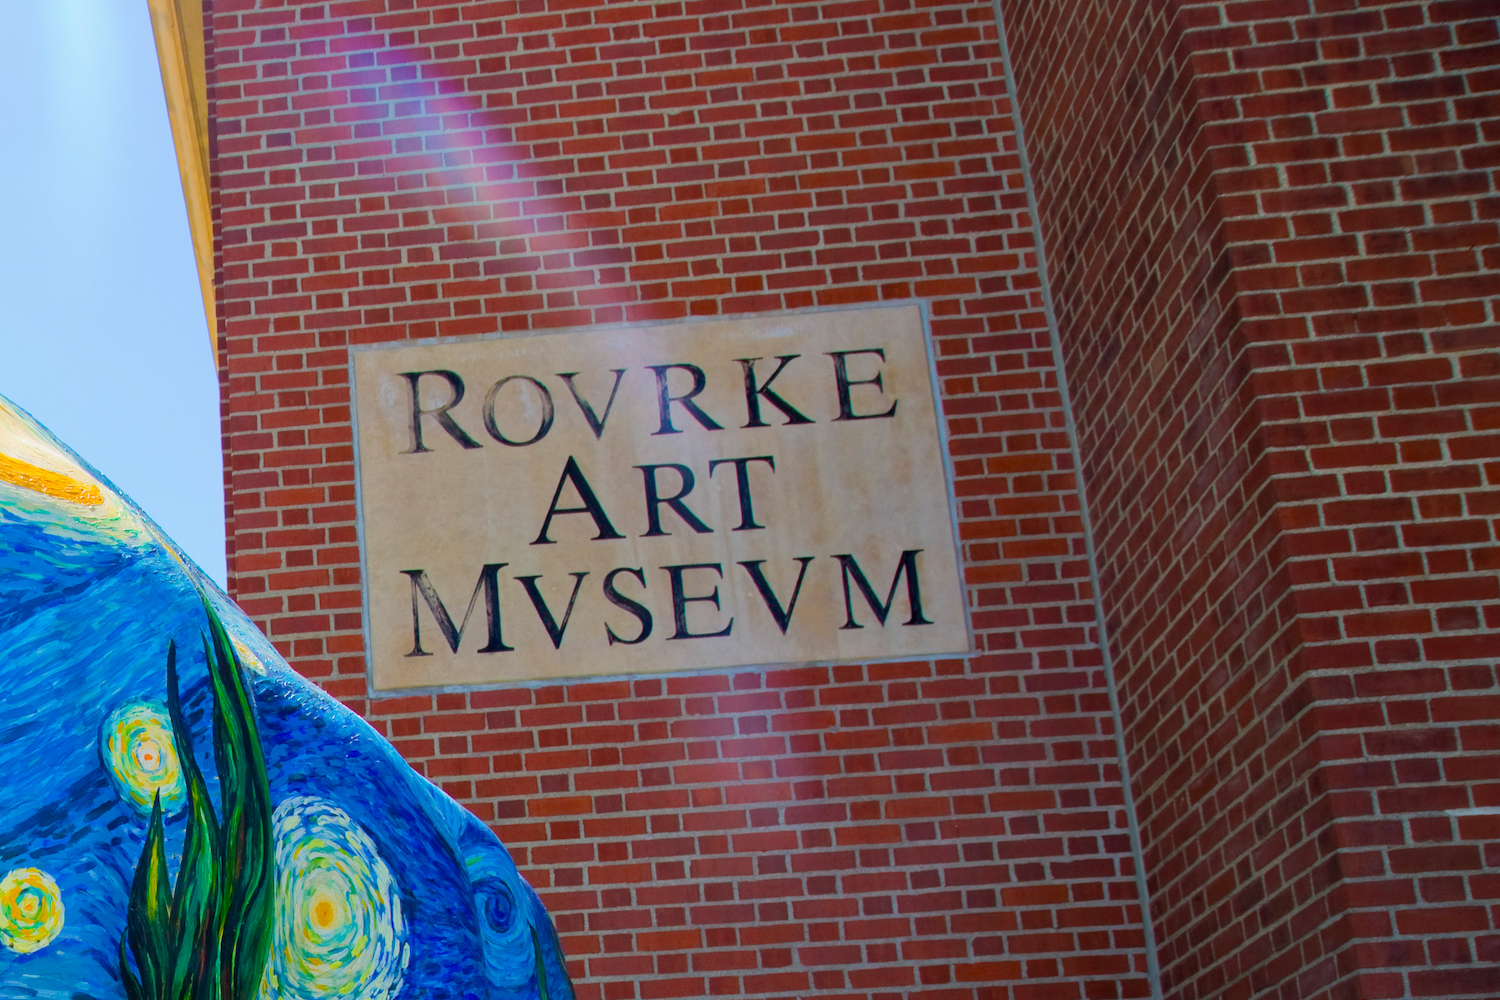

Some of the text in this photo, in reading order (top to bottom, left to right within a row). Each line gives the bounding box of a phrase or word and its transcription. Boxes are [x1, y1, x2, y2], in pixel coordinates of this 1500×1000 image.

[396, 347, 898, 454] ROVRKE
[529, 454, 776, 545] ART
[399, 548, 935, 658] MVSEVM
